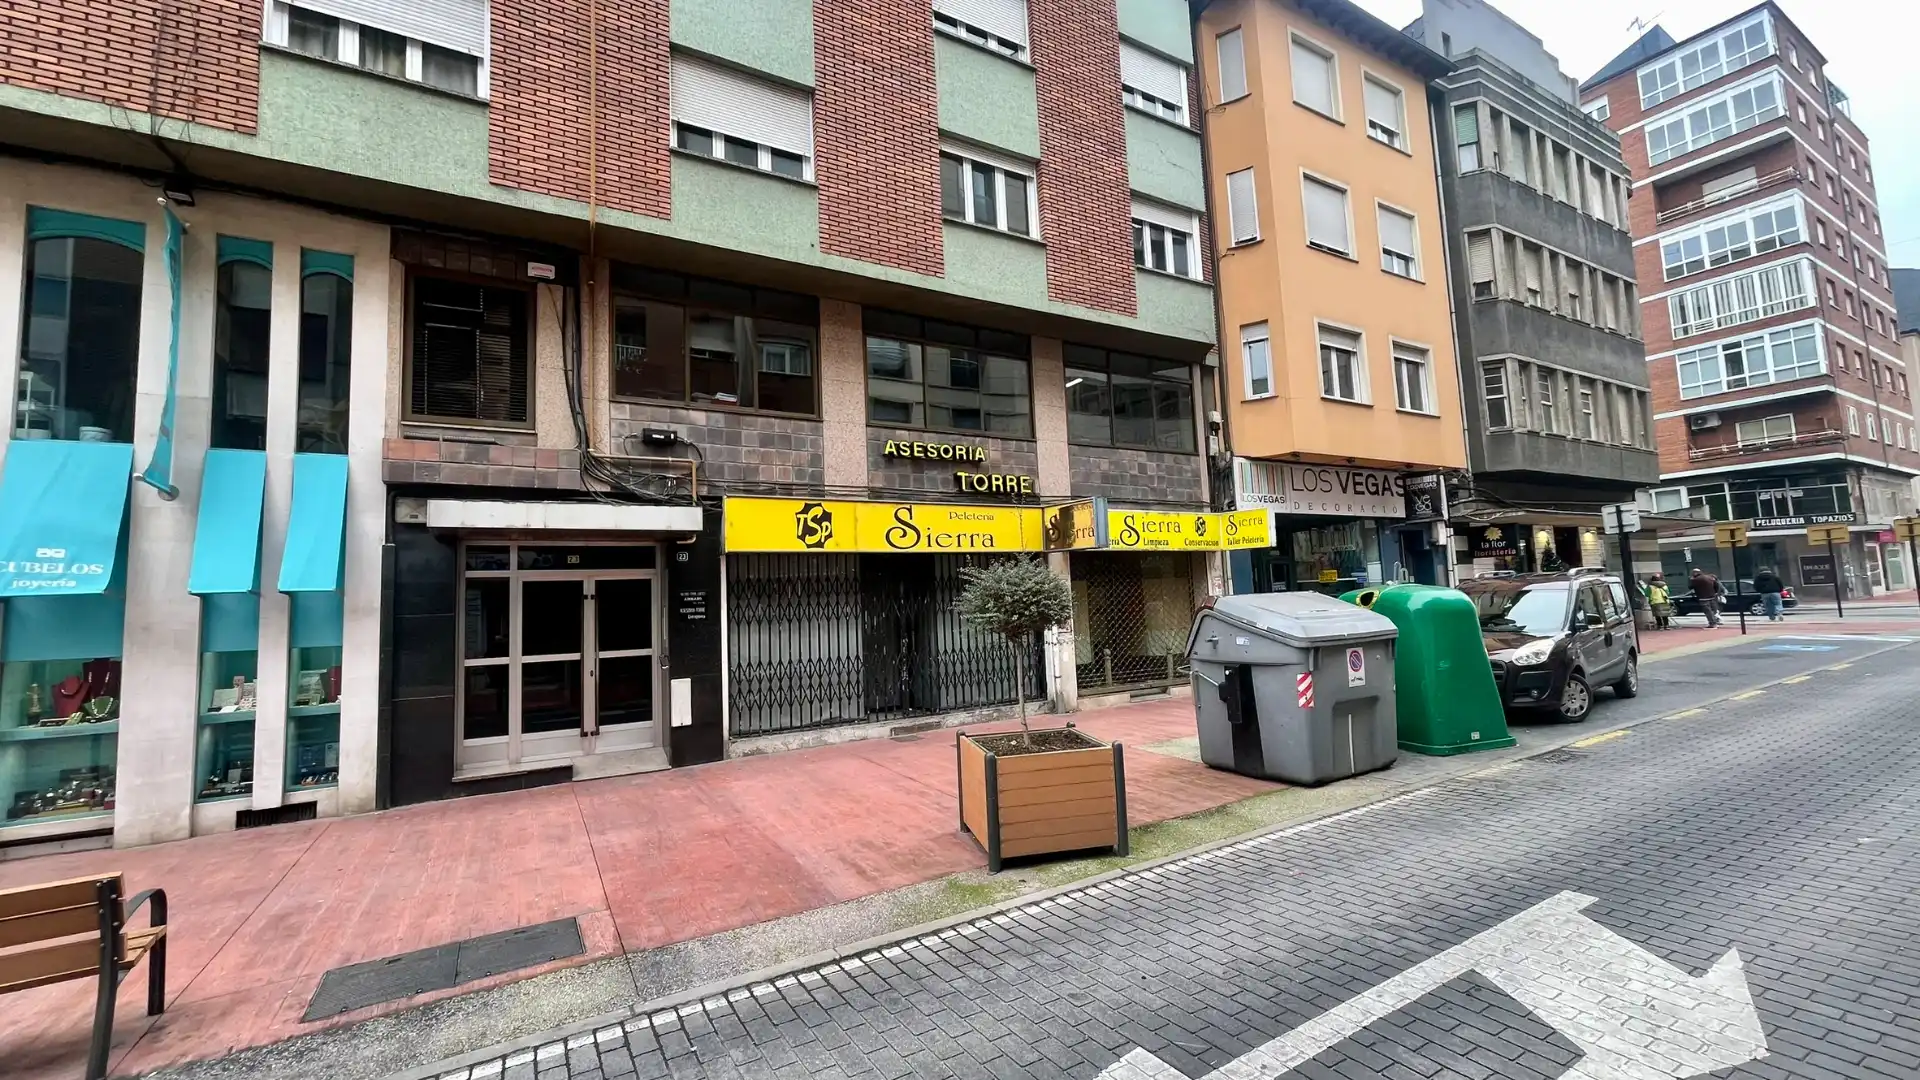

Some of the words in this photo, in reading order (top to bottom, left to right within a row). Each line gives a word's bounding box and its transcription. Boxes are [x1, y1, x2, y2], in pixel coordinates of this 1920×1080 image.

[884, 440, 986, 461] ASESORIA
[957, 471, 1032, 493] TORRE
[885, 505, 995, 549] Sierra
[1120, 514, 1181, 547] Sierra
[1226, 515, 1264, 536] Sierra
[1756, 517, 1805, 526] PELUQUERIA
[1143, 537, 1169, 547] Limpieza
[1226, 537, 1241, 546] Taller
[1481, 541, 1489, 549] la
[1491, 540, 1507, 549] flor
